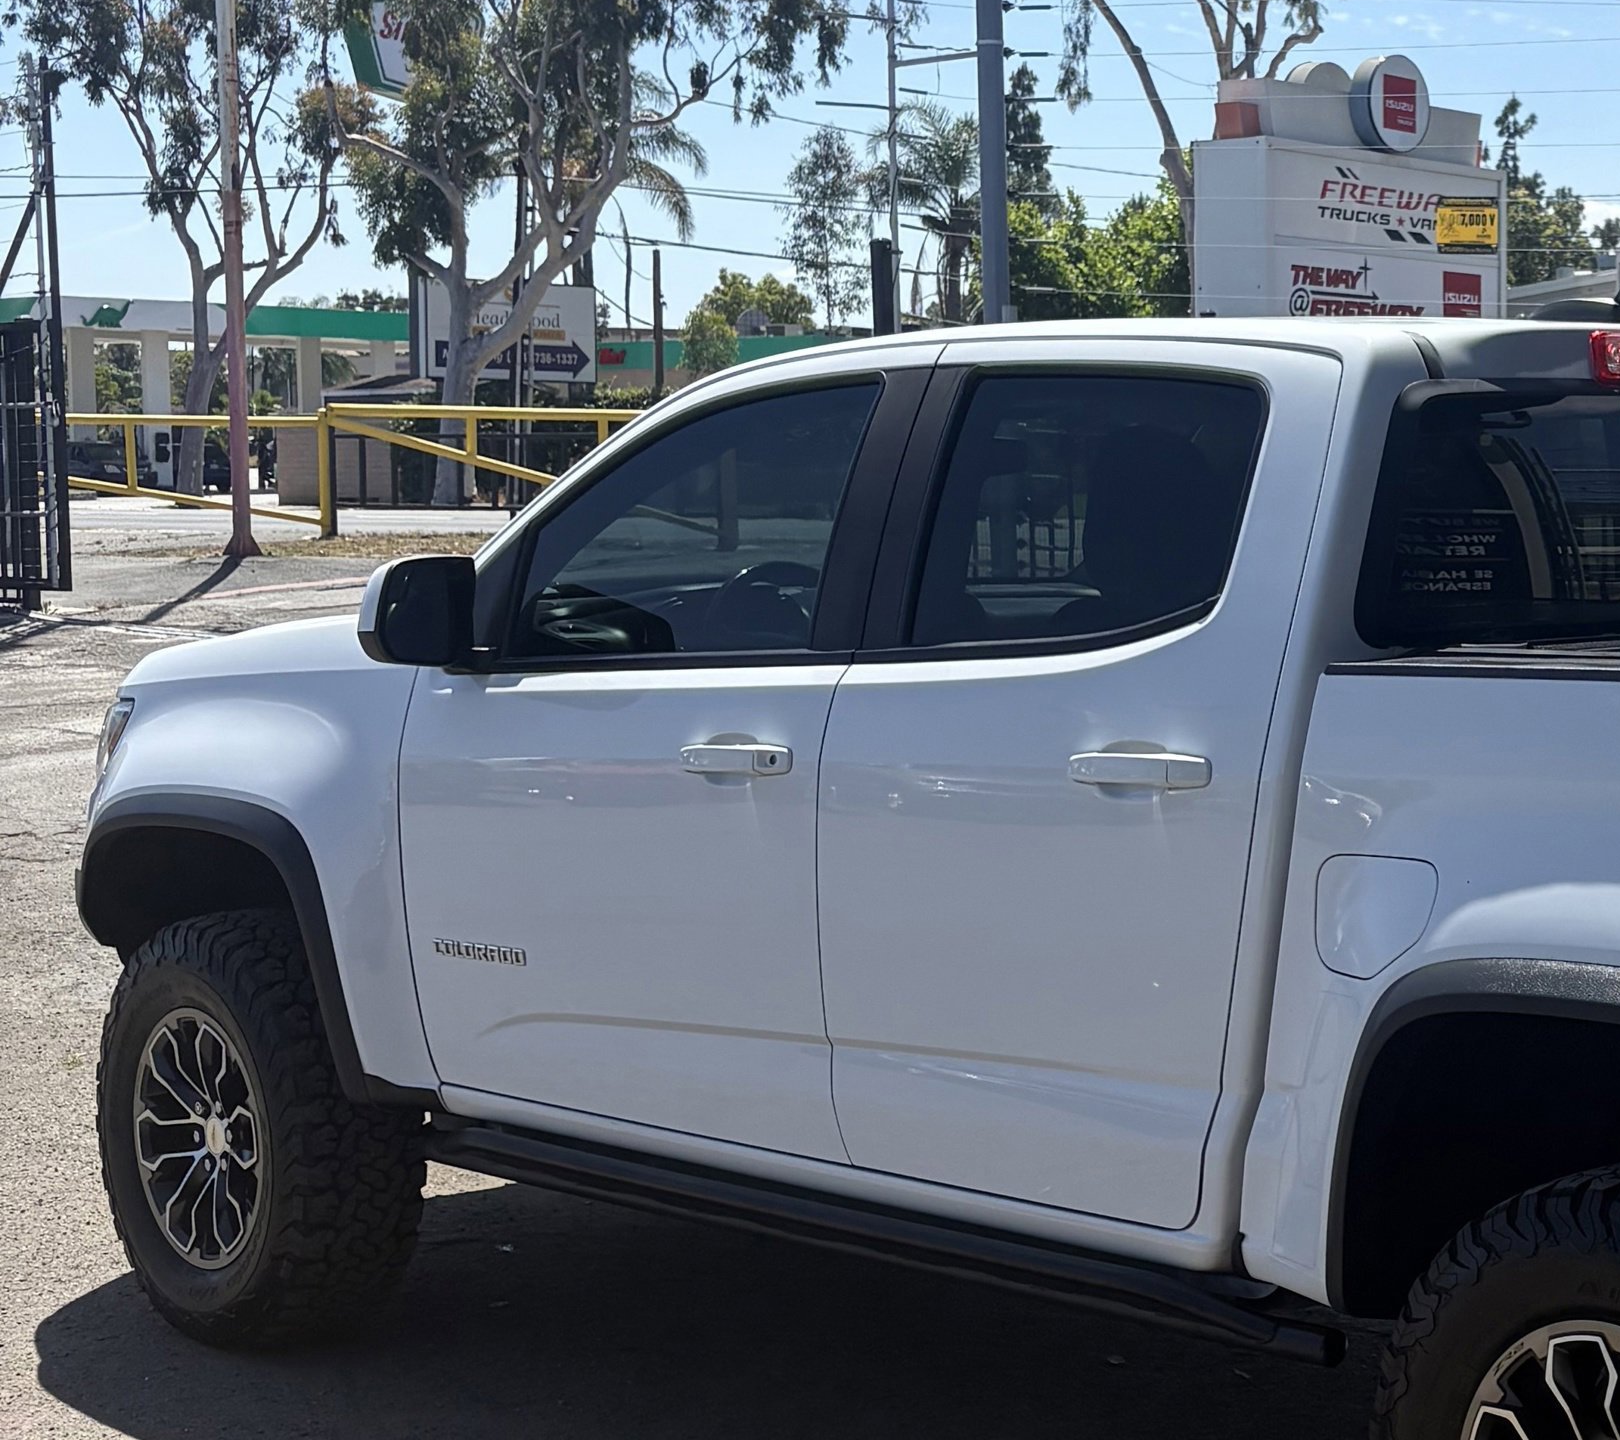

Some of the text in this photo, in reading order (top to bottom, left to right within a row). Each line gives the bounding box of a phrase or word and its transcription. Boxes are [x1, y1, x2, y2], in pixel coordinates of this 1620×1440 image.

[1386, 99, 1414, 112] ISUZU
[1320, 180, 1442, 213] FREEWA
[1318, 206, 1391, 225] TRUCKS
[1460, 213, 1497, 228] 7,000 V
[1291, 264, 1364, 289] THE WAY
[1445, 292, 1479, 304] ISUZU
[432, 937, 527, 966] COLORADO
